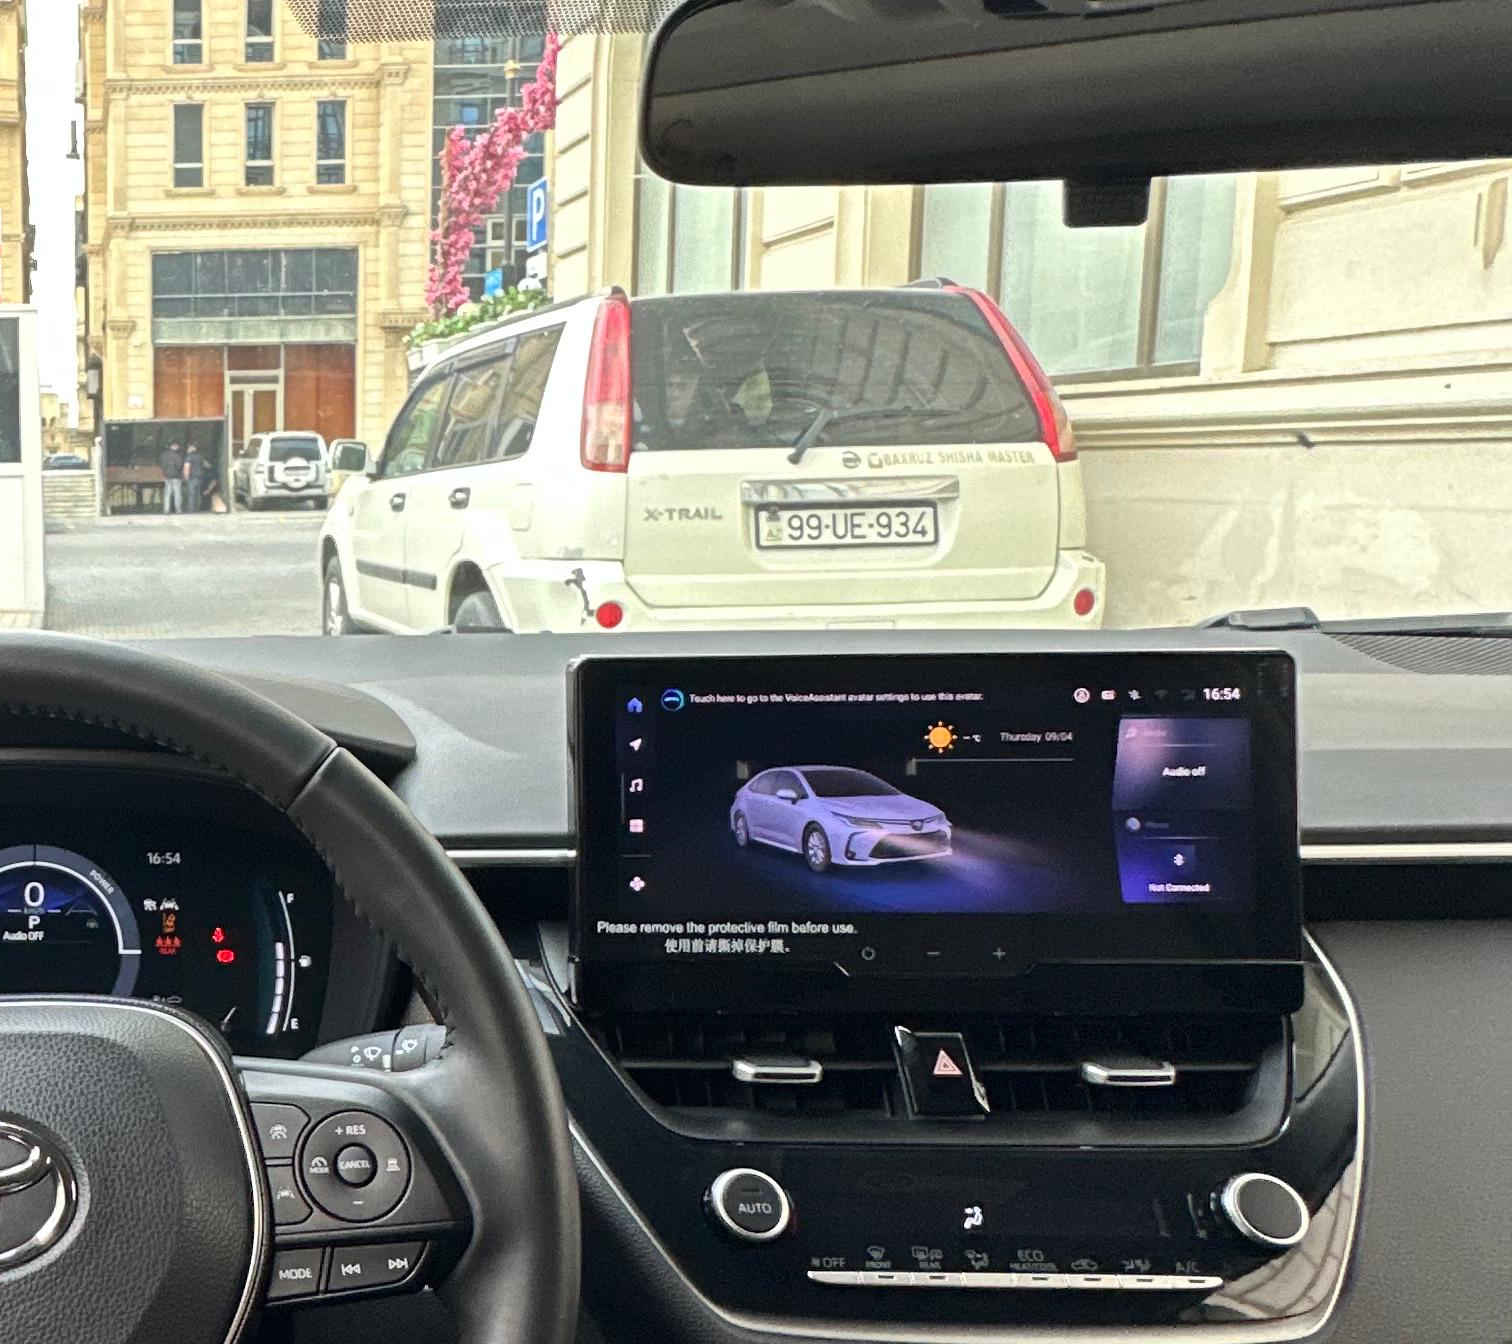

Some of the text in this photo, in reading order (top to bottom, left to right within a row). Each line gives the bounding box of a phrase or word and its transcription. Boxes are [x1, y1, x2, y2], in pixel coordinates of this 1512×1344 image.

[532, 187, 545, 242] P
[938, 451, 984, 464] SHISHA
[987, 450, 1036, 464] MASTER
[643, 507, 723, 521] X-TRAIL
[1203, 687, 1240, 701] 16:54
[999, 731, 1073, 743] Thursday 09/04
[1161, 766, 1207, 777] Audio off
[146, 852, 181, 865] 16:54
[89, 869, 115, 895] POWER
[23, 881, 46, 907] 0
[286, 892, 295, 903] F
[28, 915, 41, 929] P
[596, 920, 858, 936] Please remove the protective film before use.
[2, 930, 45, 941] Audio OFF
[290, 1018, 299, 1030] E
[345, 1124, 367, 1136] RES
[338, 1159, 371, 1170] CANCEL
[738, 1202, 772, 1214] AUTO
[821, 1257, 846, 1268] OFF
[1017, 1249, 1045, 1263] ECO
[278, 1267, 313, 1280] MODE
